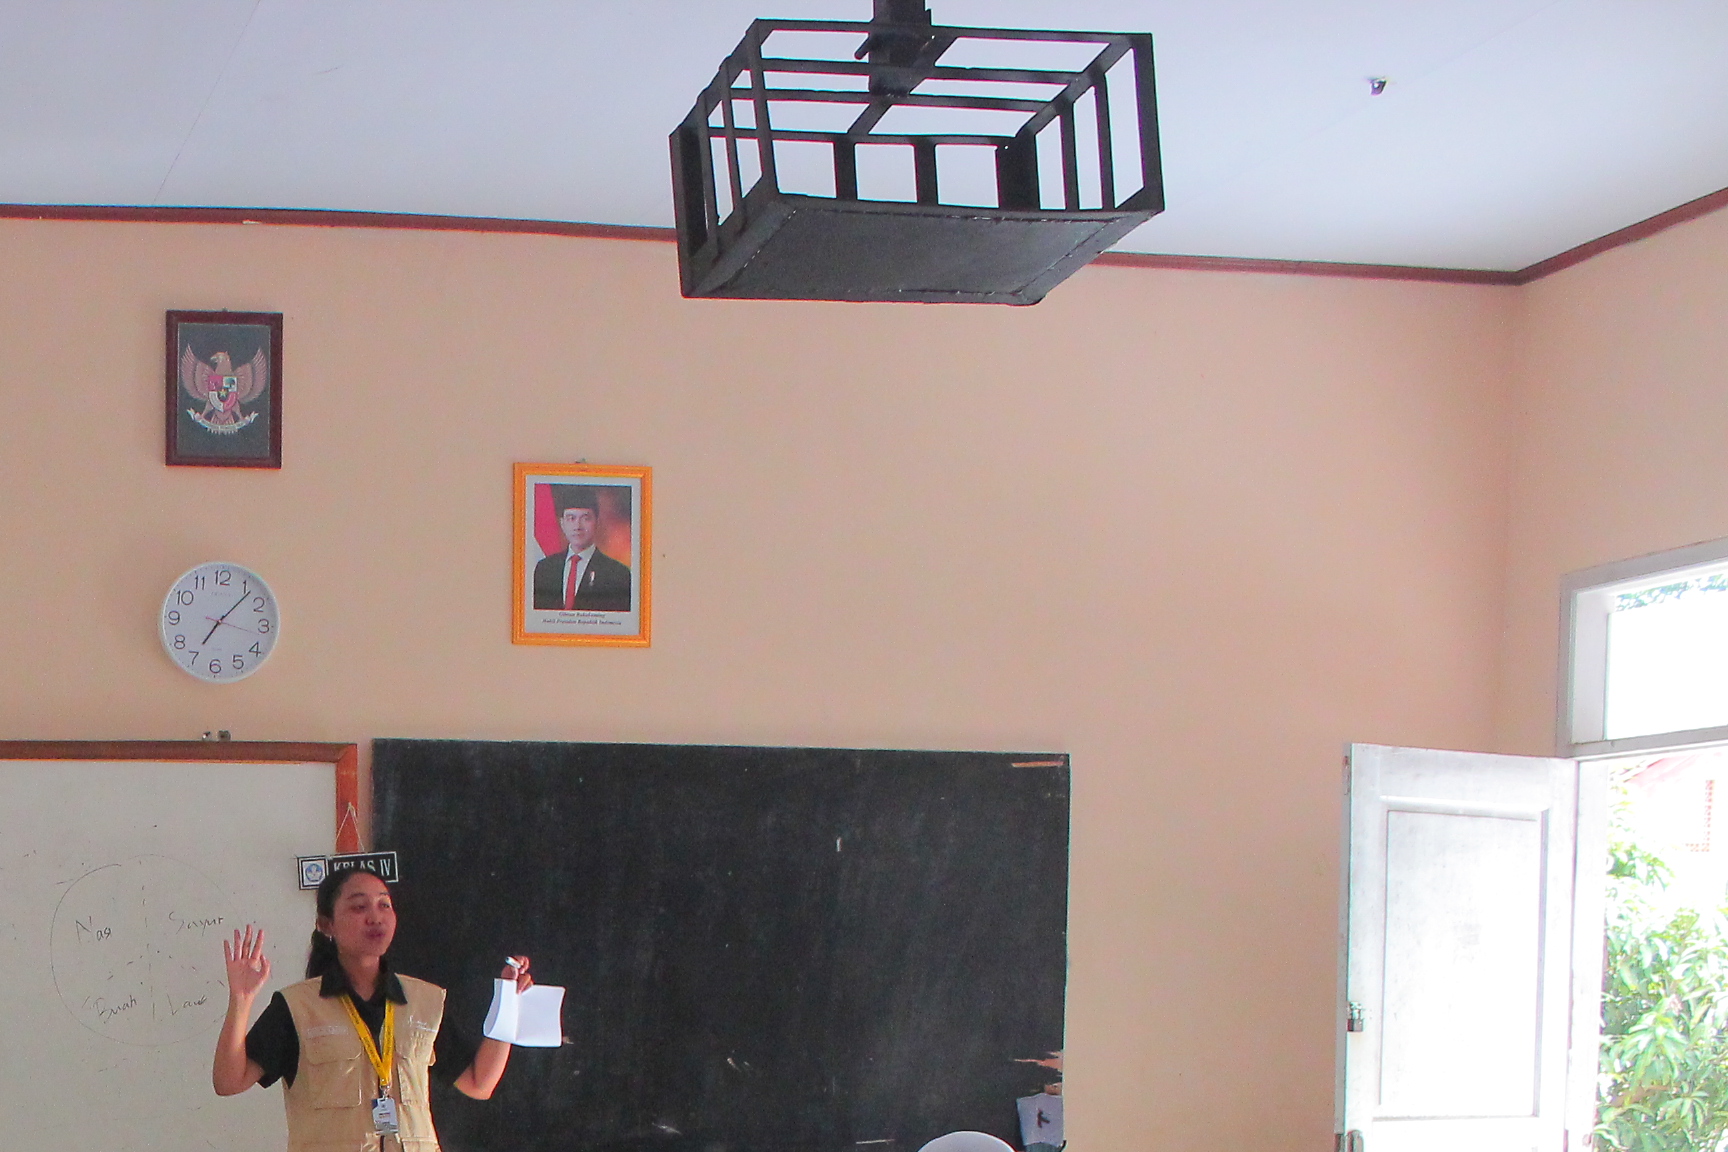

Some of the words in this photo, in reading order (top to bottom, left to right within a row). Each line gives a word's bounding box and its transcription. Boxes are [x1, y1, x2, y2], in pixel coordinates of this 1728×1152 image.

[194, 575, 206, 591] 11
[215, 570, 232, 586] 12
[242, 580, 247, 594] 1
[176, 590, 194, 606] 10
[253, 597, 265, 612] 2
[168, 610, 180, 625] 9
[258, 619, 270, 634] 3
[174, 634, 186, 650] 8
[248, 641, 262, 658] 4
[188, 650, 199, 666] 7
[232, 654, 244, 670] 5
[209, 659, 222, 674] 6
[379, 858, 391, 877] IV
